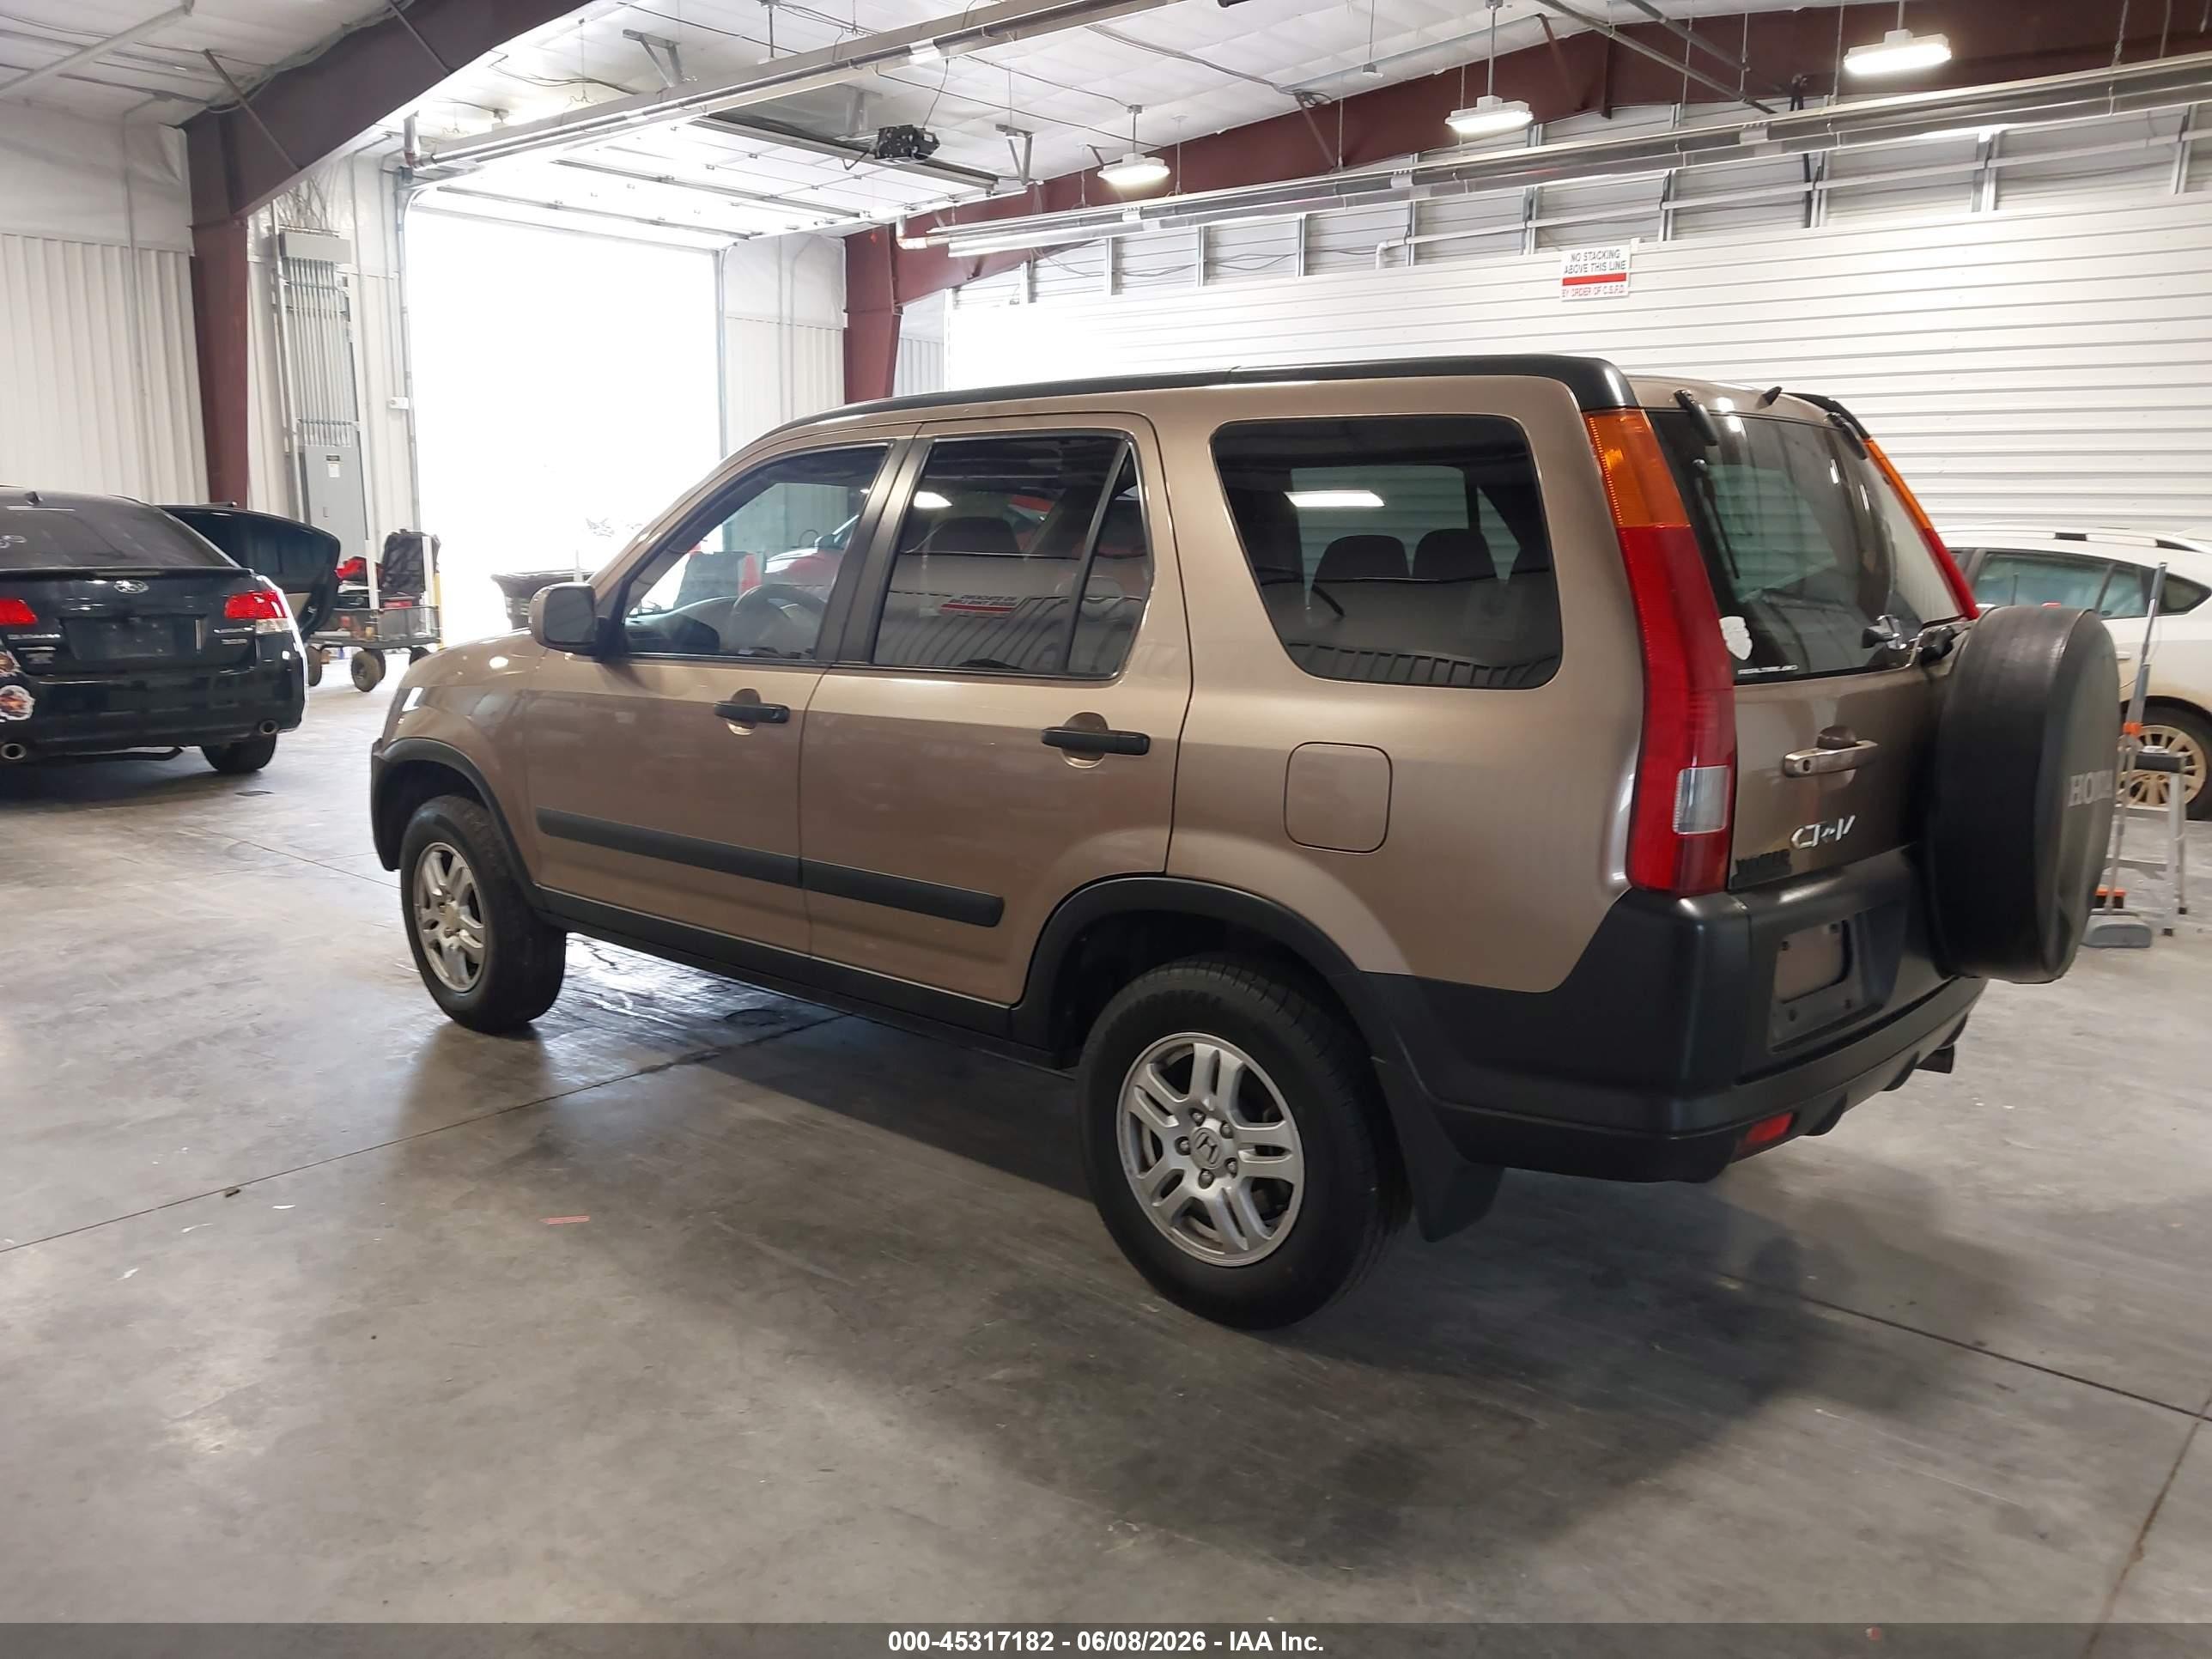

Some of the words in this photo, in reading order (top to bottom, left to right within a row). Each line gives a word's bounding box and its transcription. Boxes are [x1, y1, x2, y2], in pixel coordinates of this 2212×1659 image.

[1571, 252, 1581, 263] NO
[1583, 249, 1620, 262] STACKING
[1564, 263, 1589, 275] ABOVE
[1590, 261, 1607, 273] THIS
[1609, 260, 1627, 271] LINE
